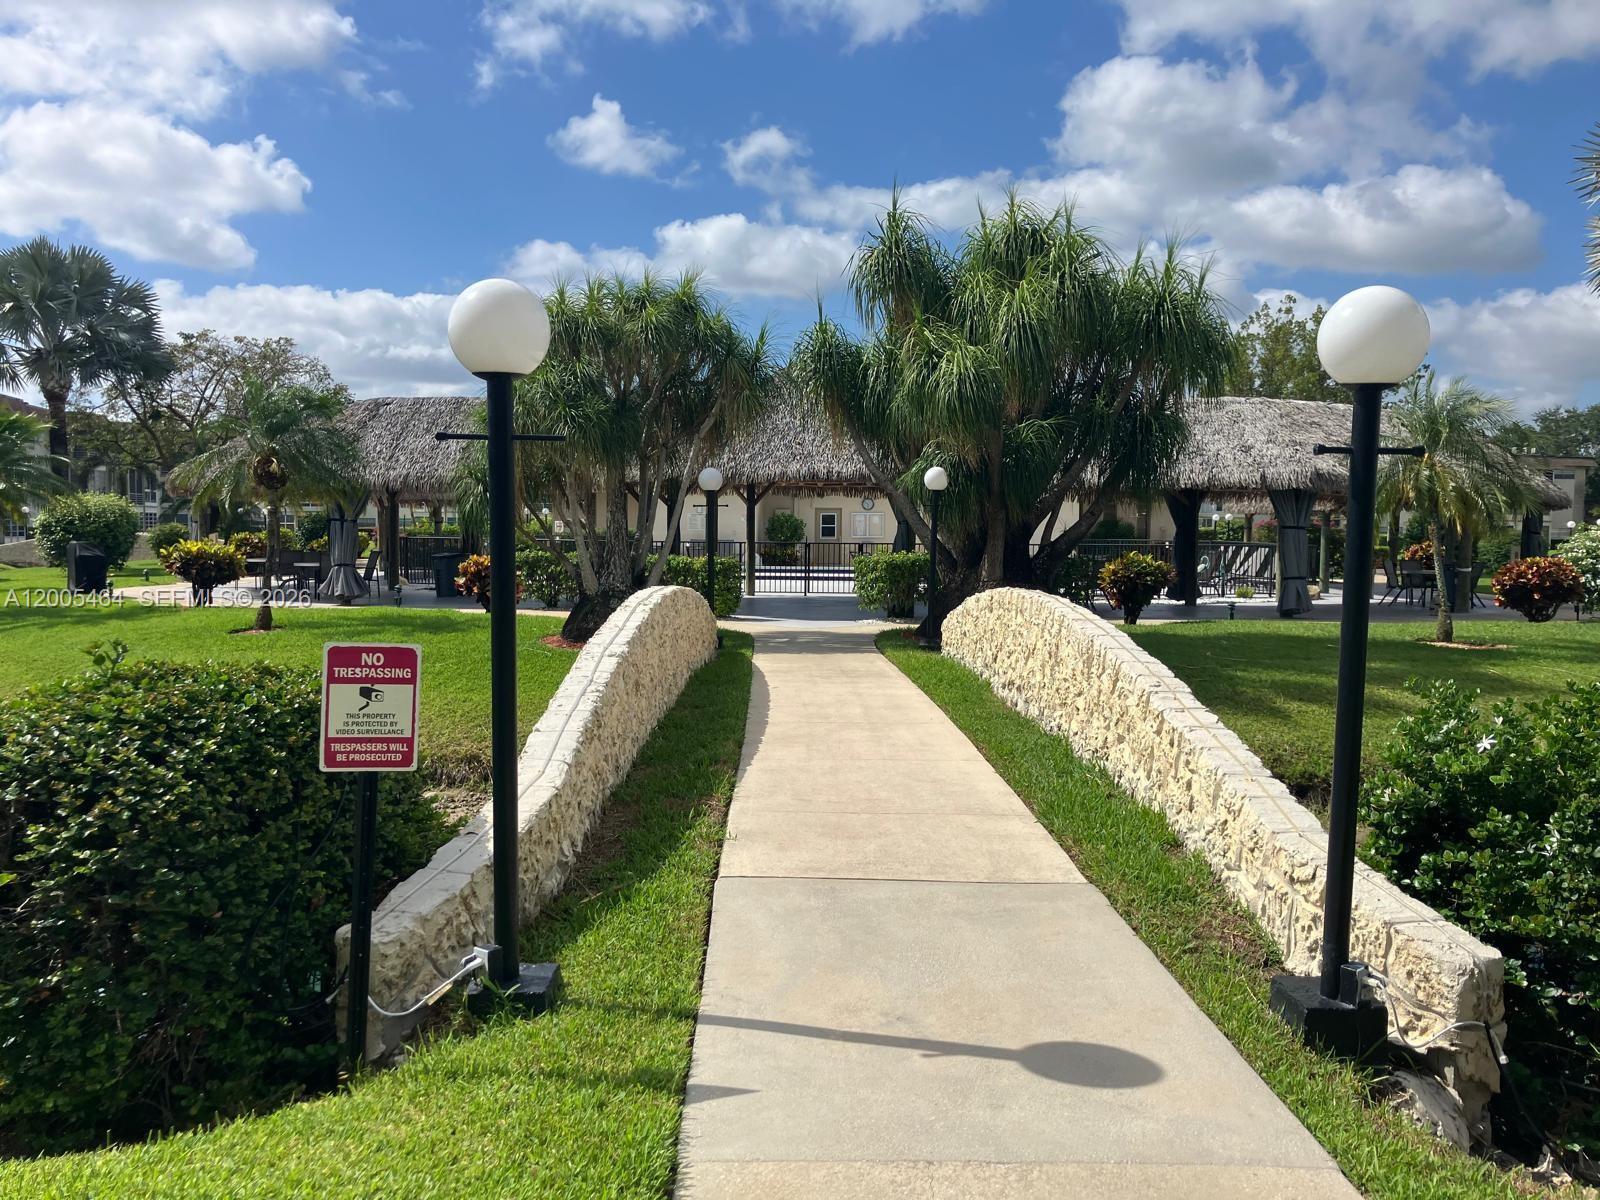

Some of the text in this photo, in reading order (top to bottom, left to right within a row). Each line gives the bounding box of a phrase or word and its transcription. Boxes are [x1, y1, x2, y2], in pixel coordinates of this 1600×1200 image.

[361, 653, 384, 666] NO
[333, 667, 411, 678] TRESPASSING
[330, 743, 408, 751] TRESPASSERS WILL
